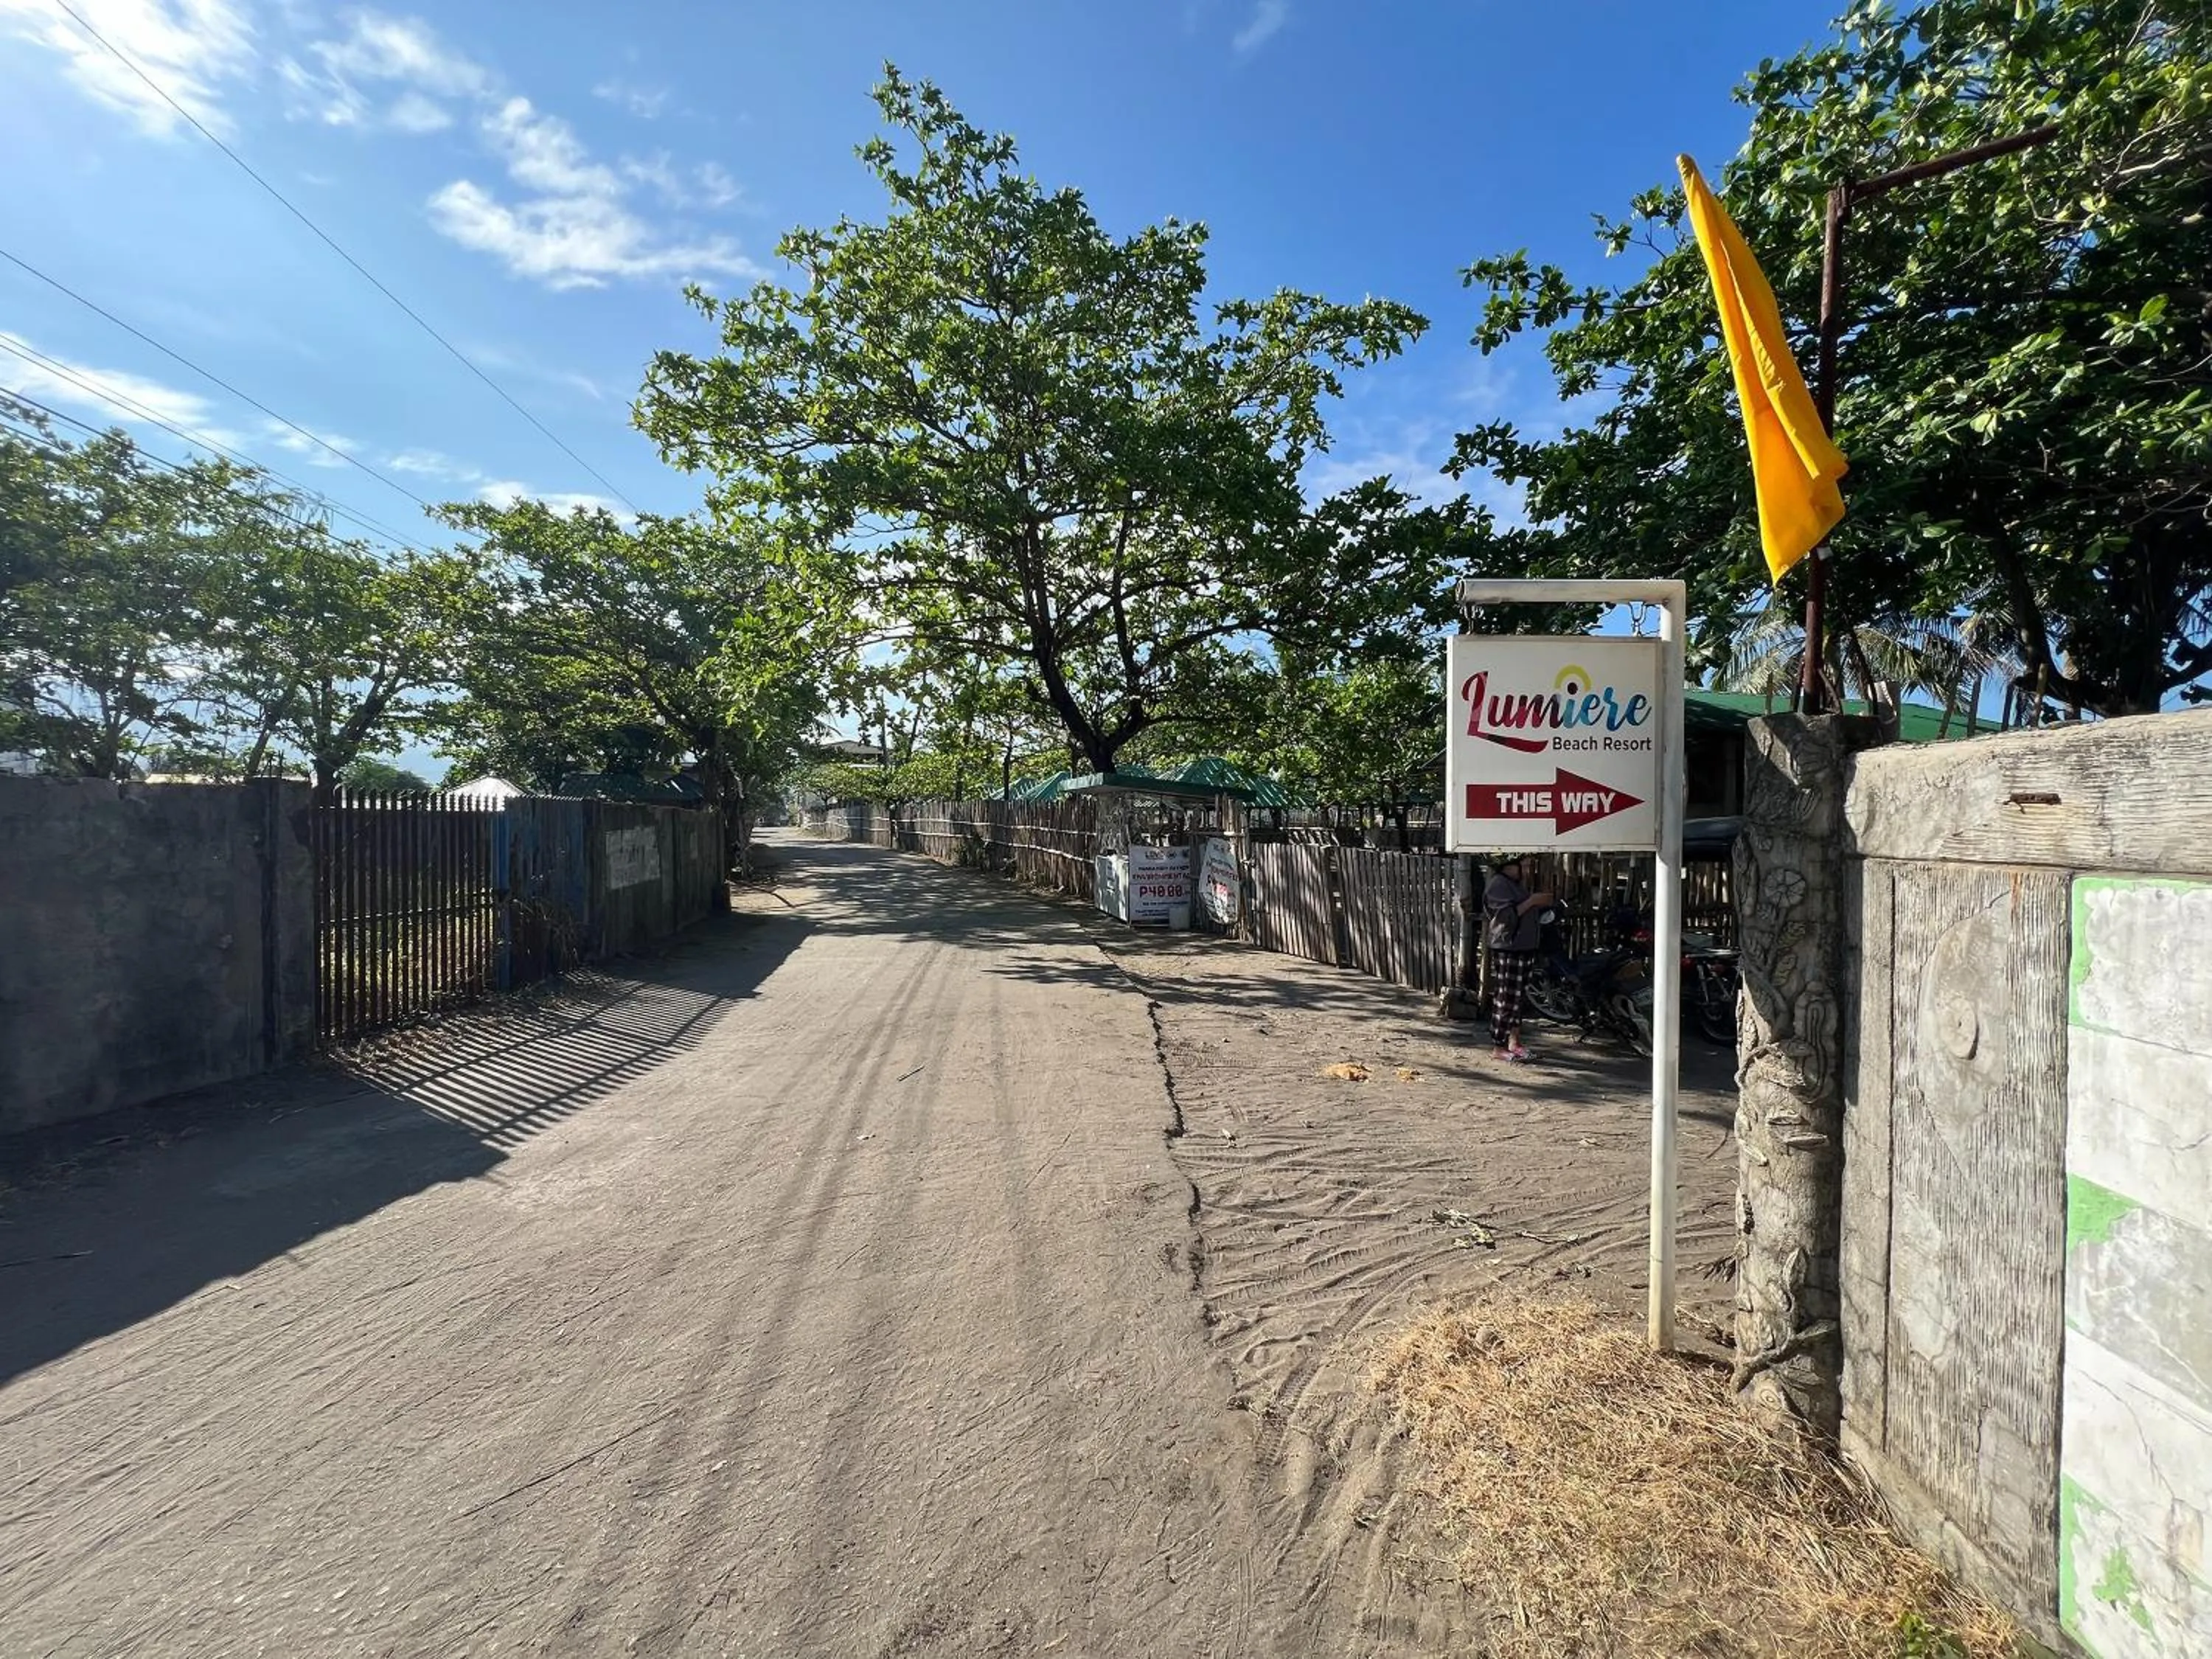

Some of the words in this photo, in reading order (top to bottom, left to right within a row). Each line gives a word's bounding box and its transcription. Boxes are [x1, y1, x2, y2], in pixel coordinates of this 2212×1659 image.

[1462, 670, 1652, 754] Lumiere
[1552, 737, 1598, 751] Beach
[1603, 737, 1652, 751] Resort
[1496, 792, 1552, 813] THIS
[1561, 792, 1615, 813] WAY
